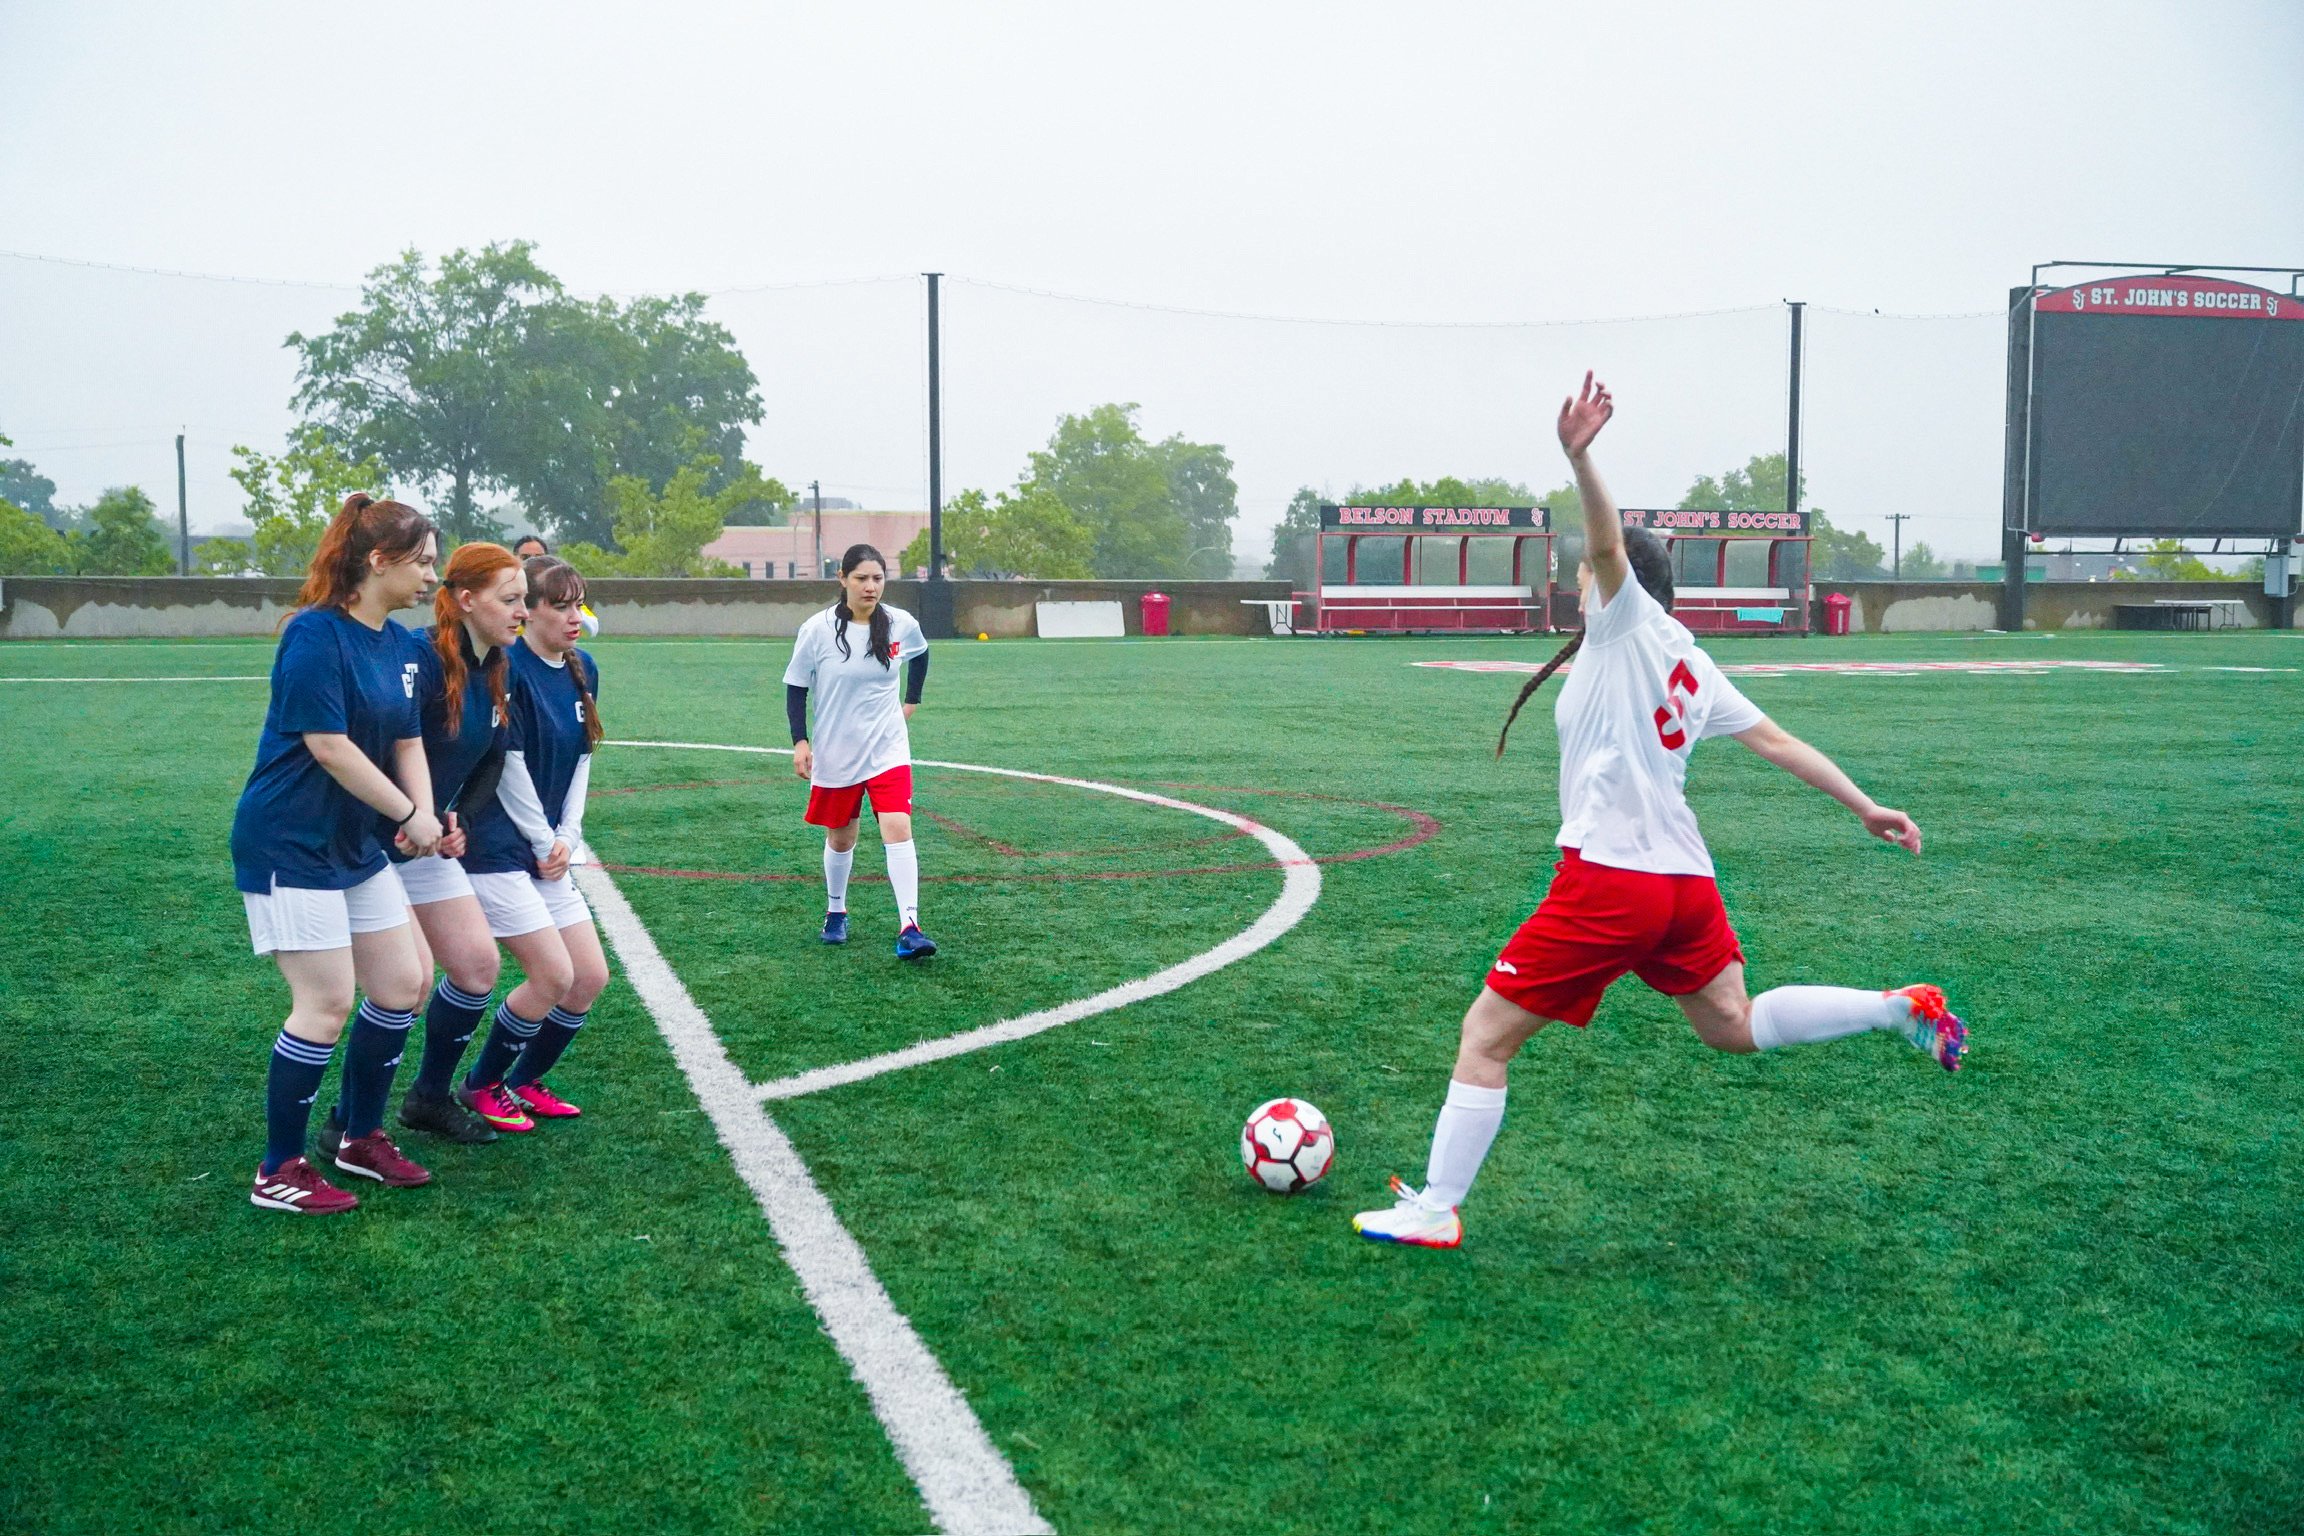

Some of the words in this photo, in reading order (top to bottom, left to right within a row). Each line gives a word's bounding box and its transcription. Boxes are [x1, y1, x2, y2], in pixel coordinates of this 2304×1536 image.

[2091, 287, 2119, 305] ST.
[2124, 288, 2189, 307] JOHN'S
[2193, 291, 2262, 310] SOCCER
[1339, 507, 1415, 525] BELSON
[1422, 507, 1510, 526] STADIUM
[1623, 510, 1646, 527] ST
[1653, 511, 1721, 528] JOHN'S
[1728, 512, 1801, 530] SOCCER
